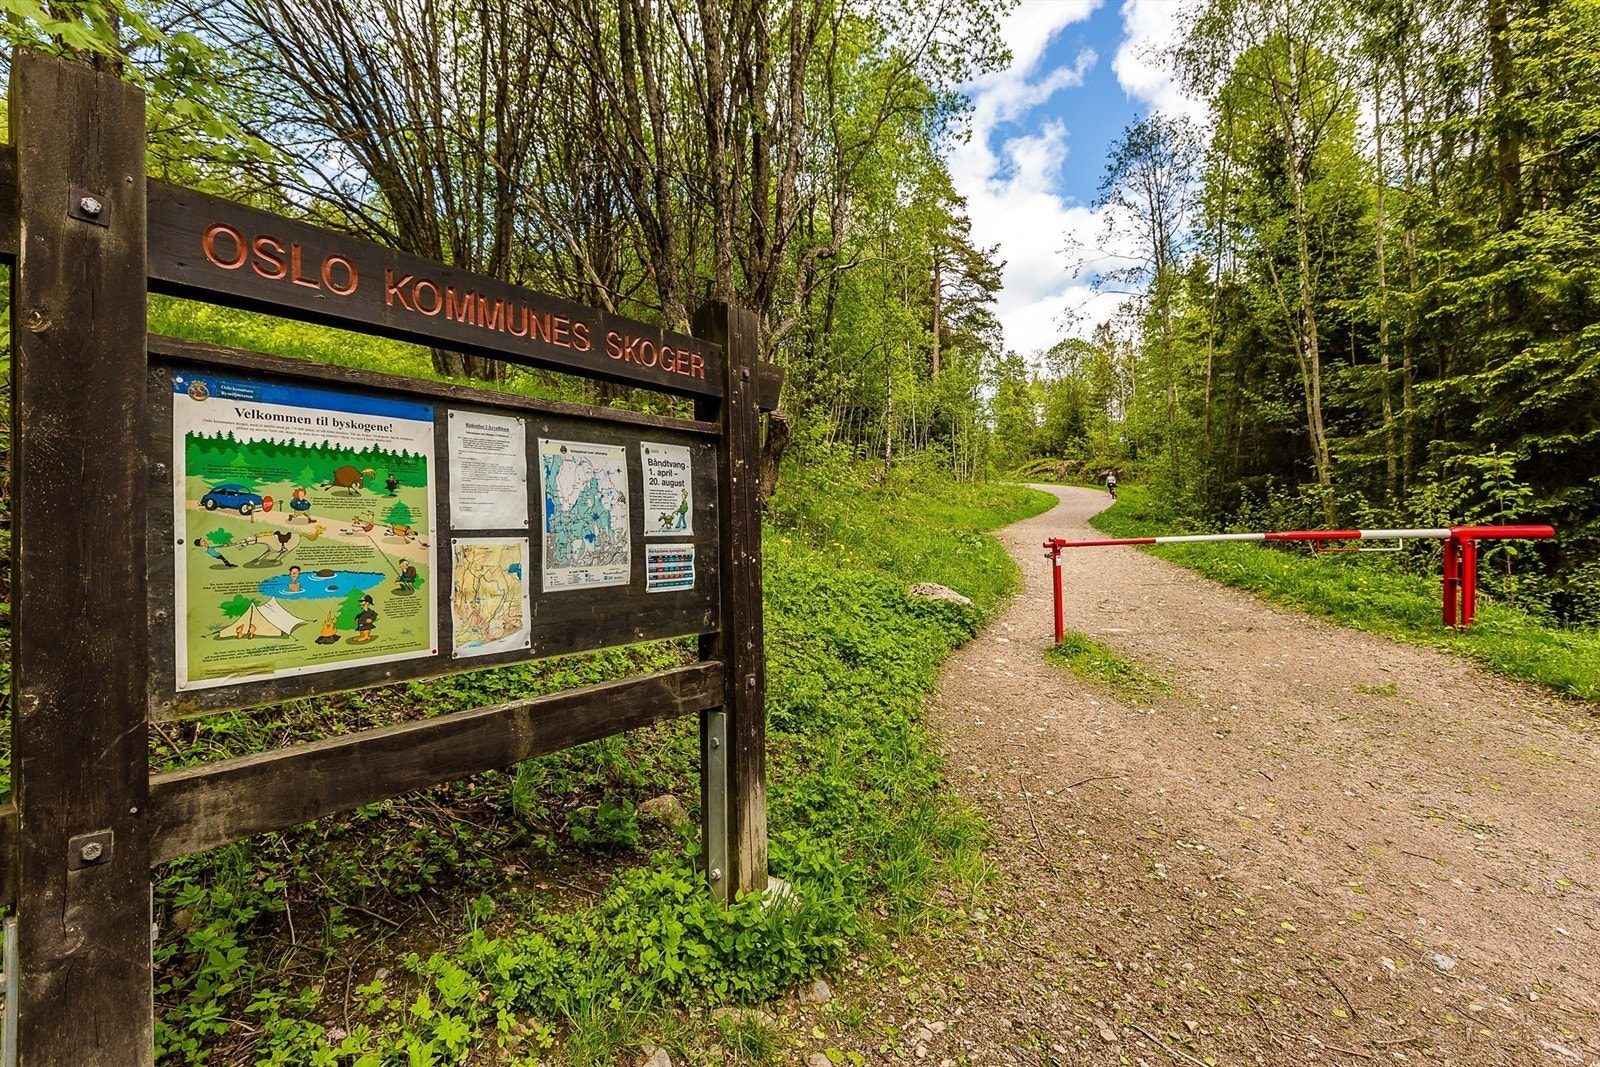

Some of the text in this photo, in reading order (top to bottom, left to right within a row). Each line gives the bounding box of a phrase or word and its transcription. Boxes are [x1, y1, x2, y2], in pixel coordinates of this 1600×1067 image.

[202, 222, 707, 380] OSLO KOMMUNES SKOGER
[234, 407, 311, 424] Velkommen
[316, 416, 328, 426] til
[332, 417, 393, 433] byskogene!
[648, 458, 685, 471] Båndtvang
[649, 468, 656, 476] 1.
[657, 469, 673, 478] april
[649, 477, 685, 488] 20. august
